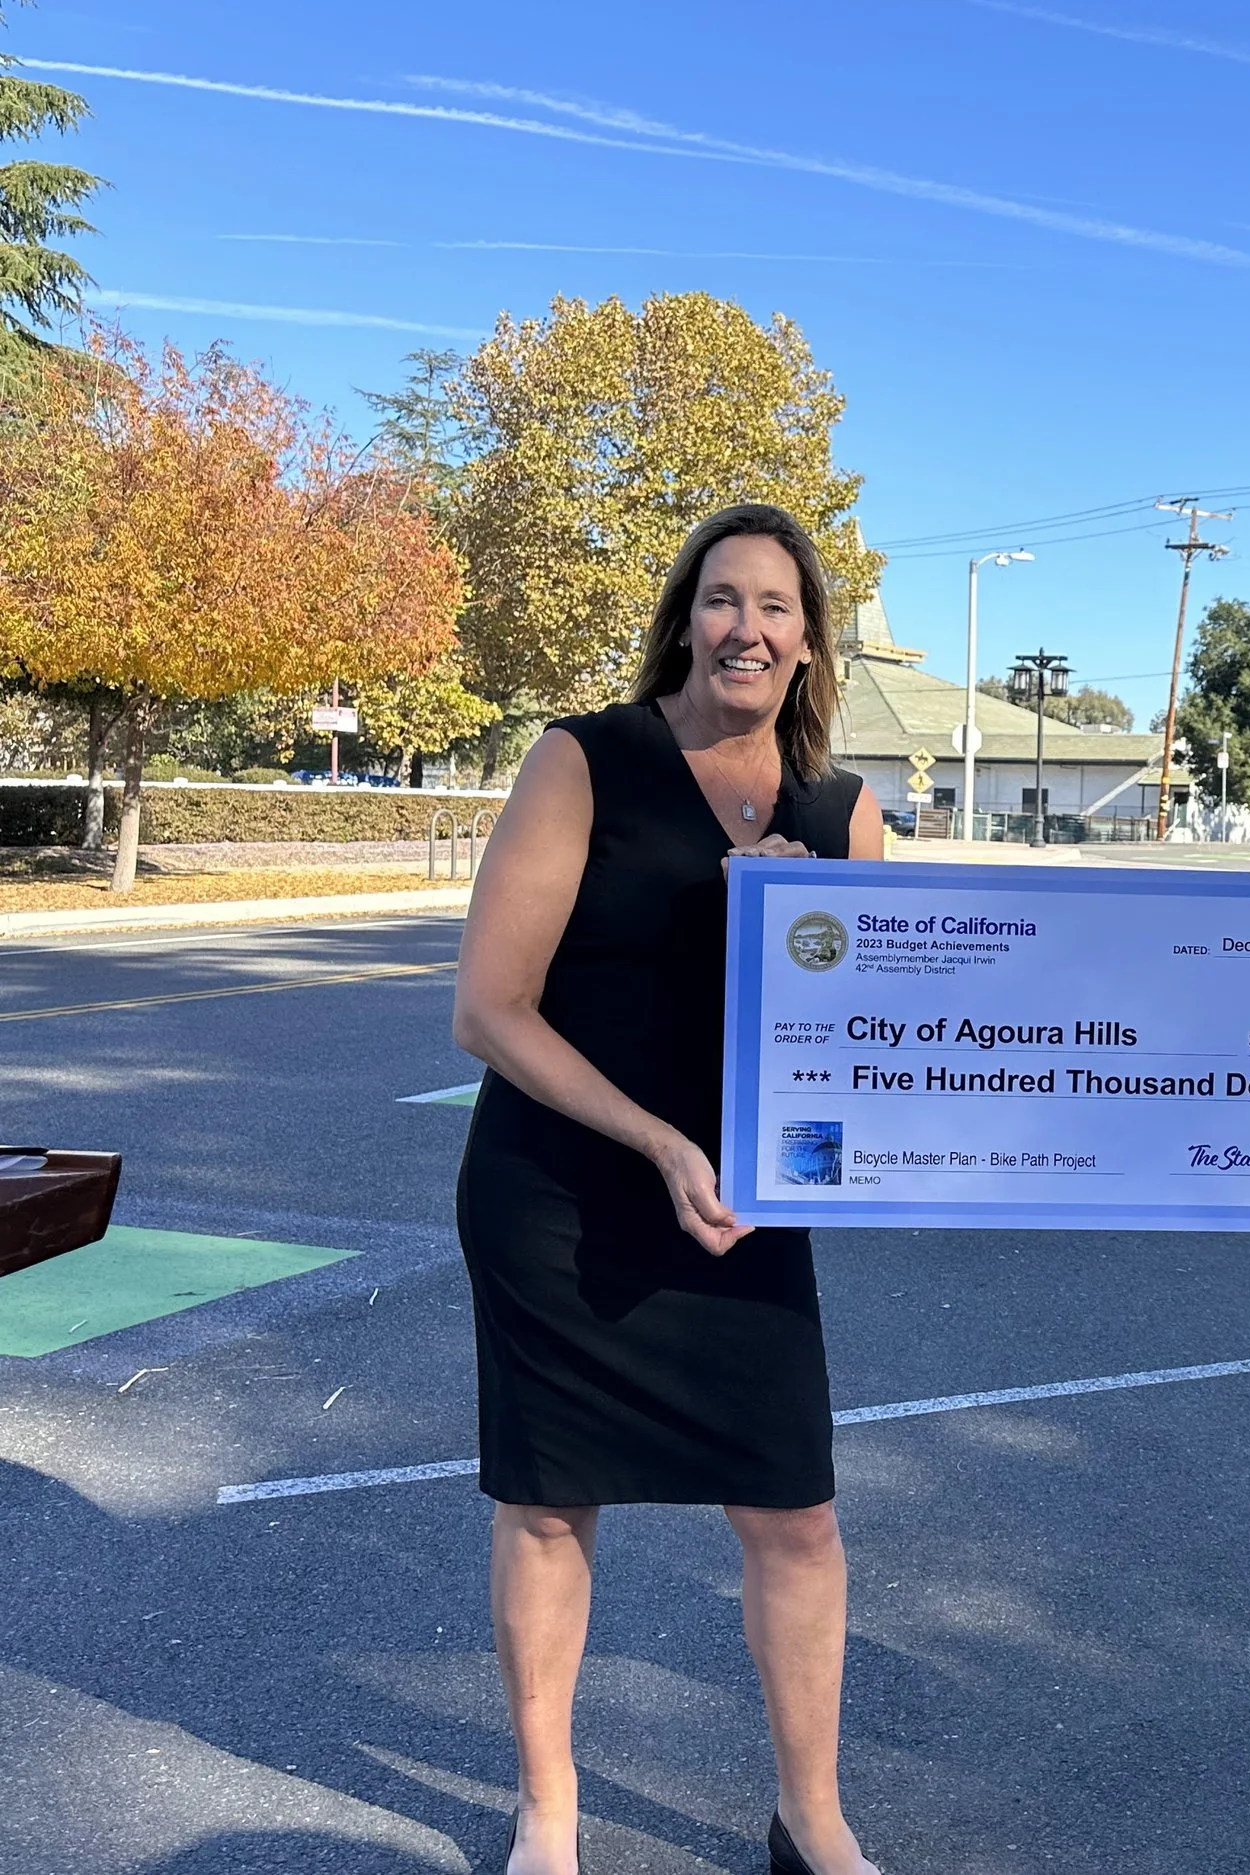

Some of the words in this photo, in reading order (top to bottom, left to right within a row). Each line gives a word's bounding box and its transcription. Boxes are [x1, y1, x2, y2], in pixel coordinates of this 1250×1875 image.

[857, 914, 909, 933] State
[915, 916, 936, 934] of
[941, 917, 1036, 936] California
[856, 939, 883, 949] 2023
[887, 940, 927, 951] Budget
[930, 941, 1010, 952] Achievements
[1173, 945, 1210, 955] DATED:
[855, 953, 939, 965] Assemblymember
[941, 955, 971, 966] Jacqui
[974, 956, 996, 965] Irwin
[876, 965, 922, 975] Assembly
[924, 966, 956, 975] District
[774, 1022, 796, 1032] PAY
[798, 1023, 812, 1032] TO
[815, 1023, 836, 1032] THE
[847, 1016, 906, 1047] City
[917, 1018, 947, 1042] of
[955, 1018, 1063, 1049] Agoura
[1075, 1021, 1138, 1046] Hills
[774, 1034, 812, 1044] ORDER
[814, 1035, 830, 1044] OF
[853, 1066, 914, 1090] Five
[925, 1067, 1055, 1093] Hundred
[1066, 1070, 1214, 1096] Thousand
[853, 1151, 898, 1168] Bicycle
[902, 1151, 946, 1166] Master
[950, 1151, 977, 1166] Plan
[990, 1152, 1017, 1167] Bike
[1021, 1153, 1049, 1167] Path
[1053, 1153, 1096, 1170] Project
[1188, 1144, 1218, 1167] The
[849, 1176, 881, 1185] MEMO
